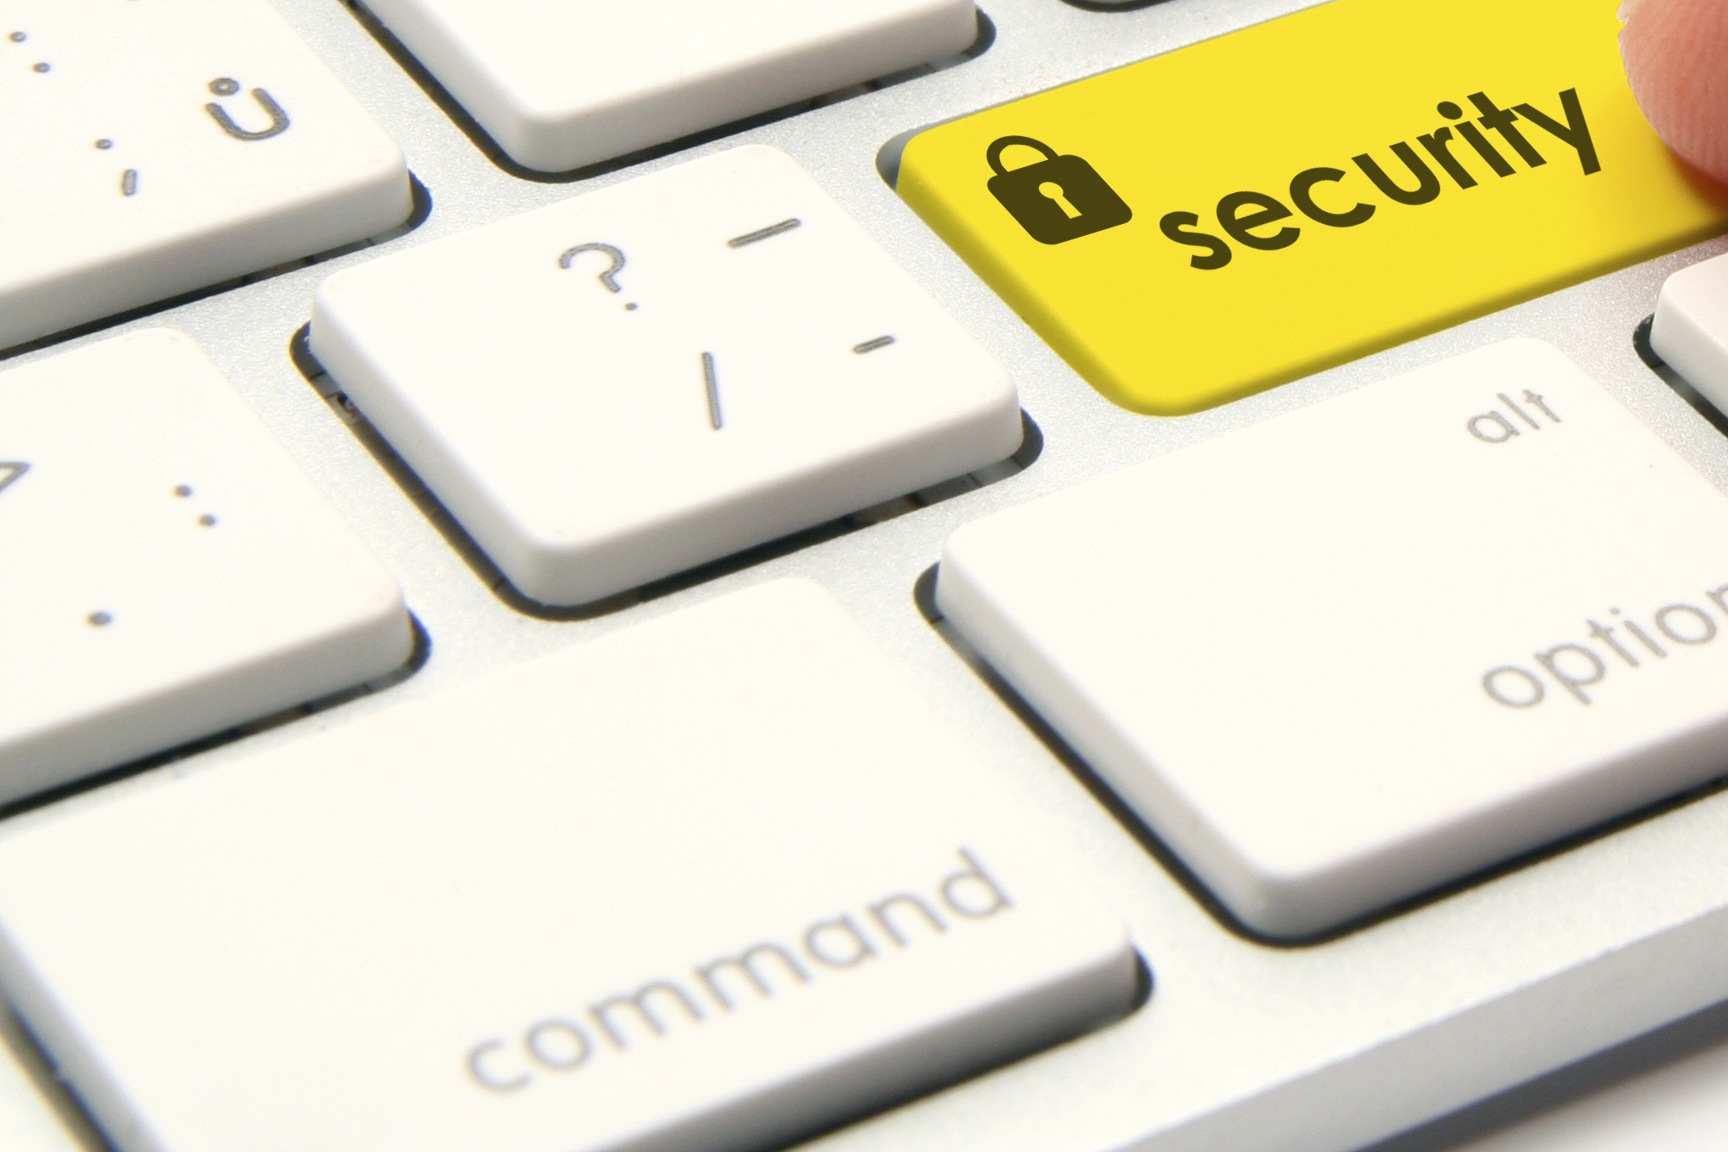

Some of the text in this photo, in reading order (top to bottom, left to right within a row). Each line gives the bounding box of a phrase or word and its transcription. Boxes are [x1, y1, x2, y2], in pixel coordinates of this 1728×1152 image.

[1159, 88, 1601, 270] security
[1466, 388, 1562, 445] alt
[463, 846, 1015, 1096] command
